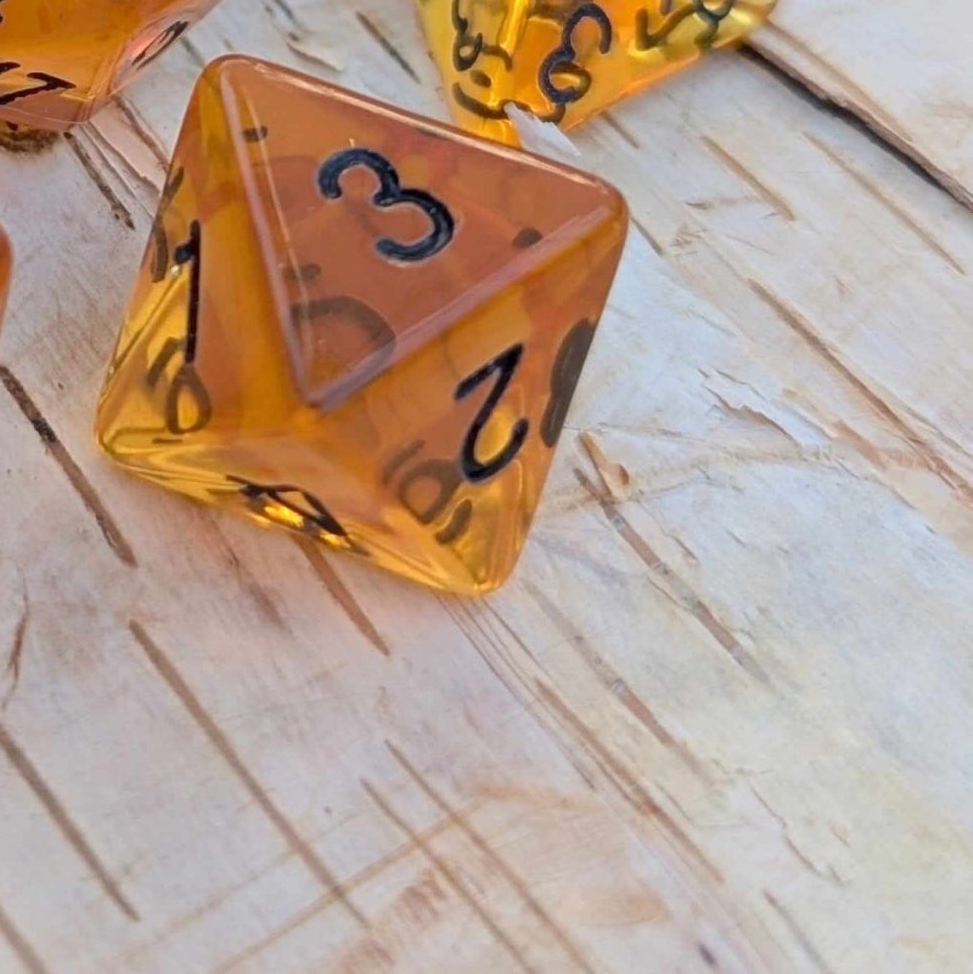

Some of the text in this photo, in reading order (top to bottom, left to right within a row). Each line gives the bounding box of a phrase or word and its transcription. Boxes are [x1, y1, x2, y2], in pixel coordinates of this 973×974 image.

[317, 148, 455, 264] 3
[174, 220, 201, 364] 1
[454, 342, 530, 484] 2
